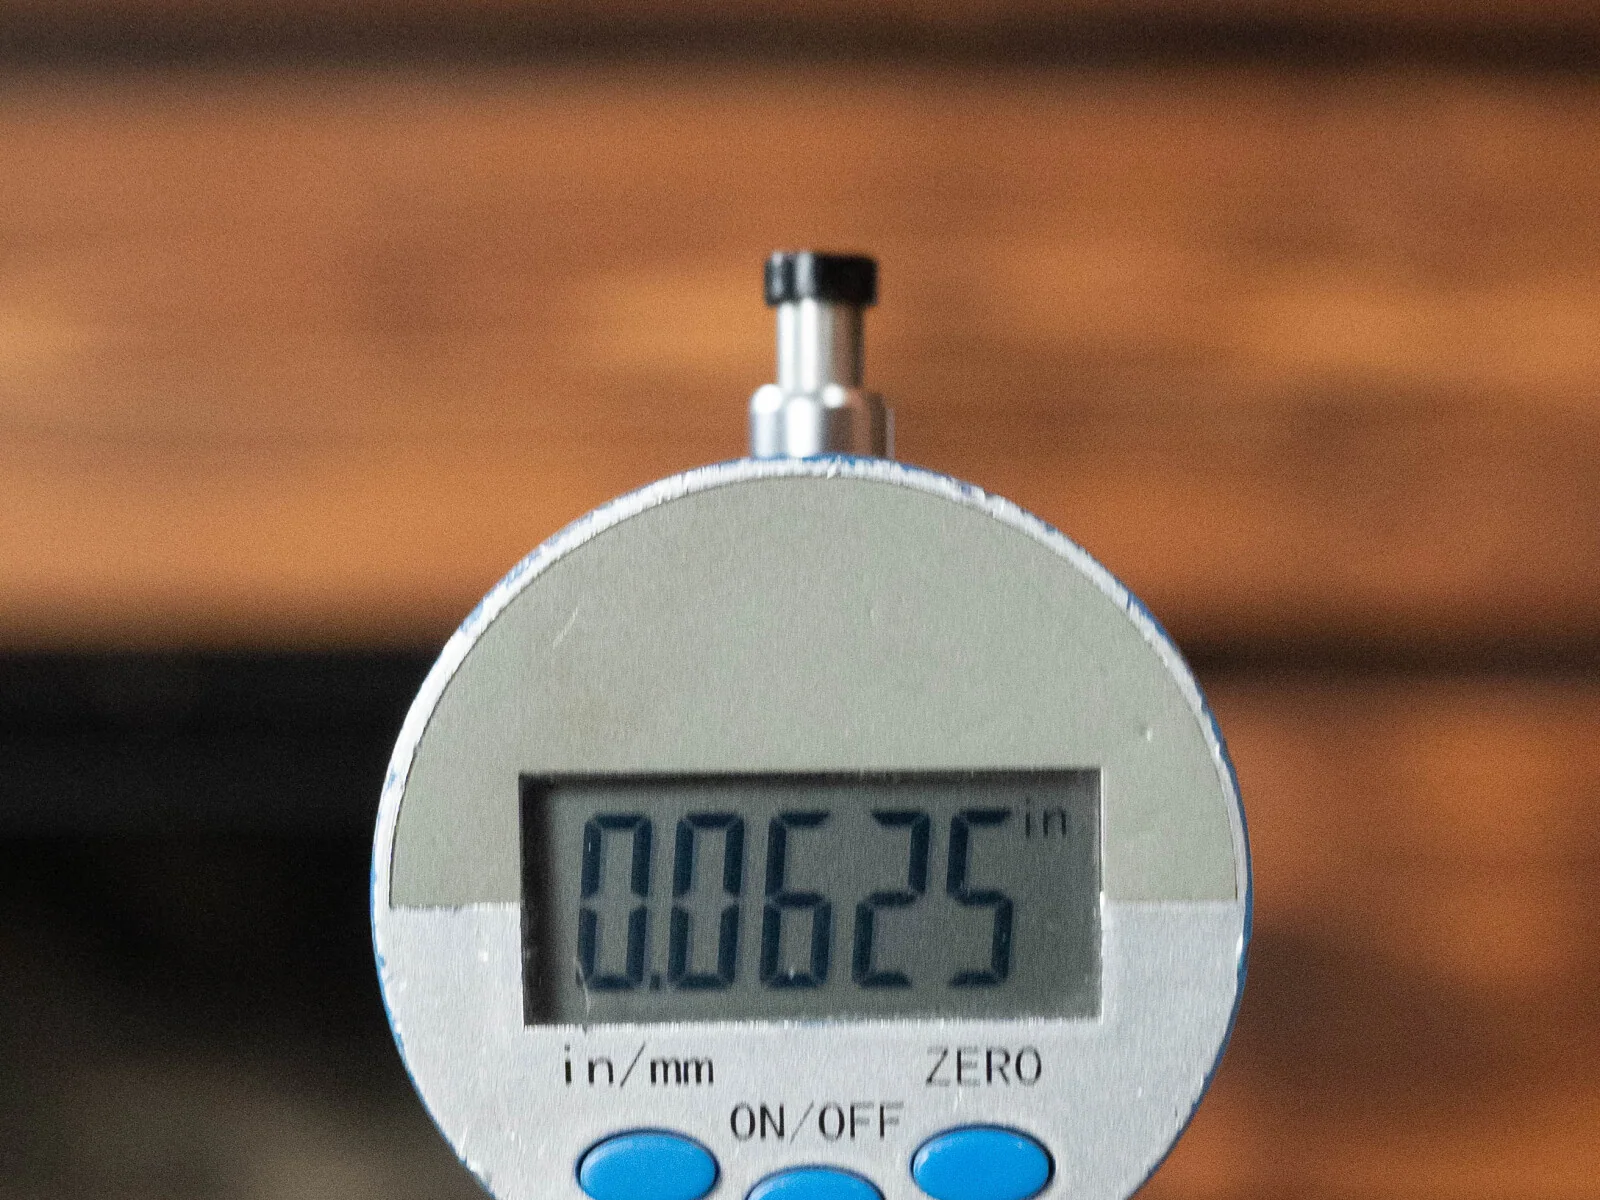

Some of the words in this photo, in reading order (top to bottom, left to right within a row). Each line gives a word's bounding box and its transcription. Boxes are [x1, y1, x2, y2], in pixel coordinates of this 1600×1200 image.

[576, 807, 1014, 990] 0.0625
[1024, 799, 1068, 839] in
[563, 1043, 715, 1088] in/mm
[925, 1045, 1042, 1088] ZERO
[729, 1101, 905, 1144] ON/OFF
